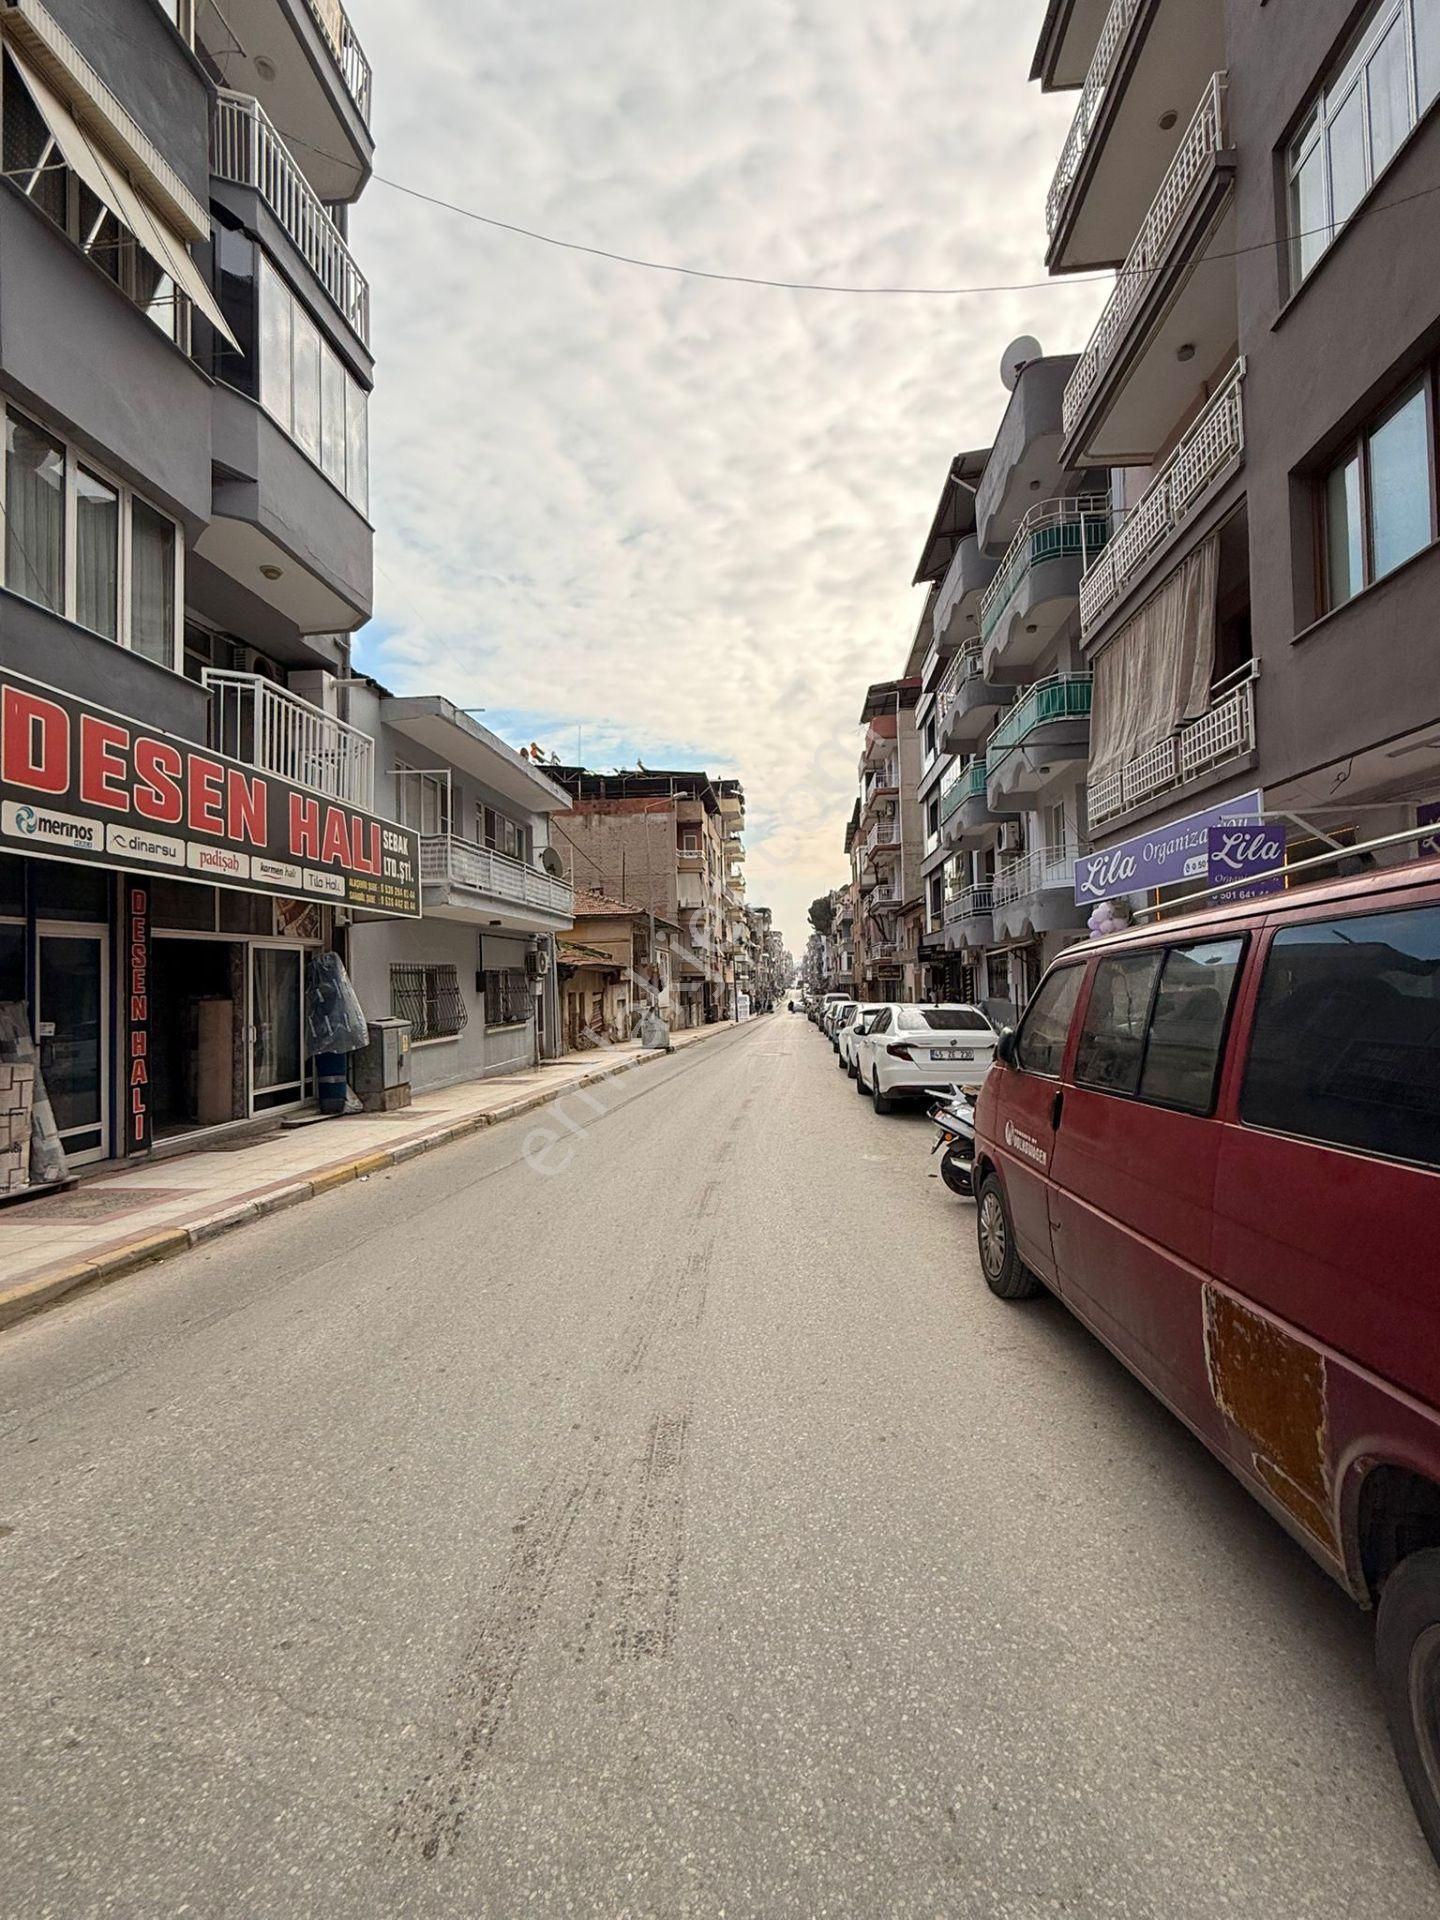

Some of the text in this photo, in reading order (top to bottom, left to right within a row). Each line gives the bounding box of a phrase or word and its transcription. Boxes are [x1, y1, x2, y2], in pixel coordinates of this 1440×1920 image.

[1, 684, 381, 877] DESEN HALI
[37, 816, 94, 842] merinos
[382, 830, 409, 856] SEBAK
[128, 837, 177, 858] dinarsu
[200, 850, 240, 873] padişah
[1211, 832, 1281, 869] Lila
[1080, 850, 1137, 897] Lila
[131, 889, 148, 1141] DESEN HALI
